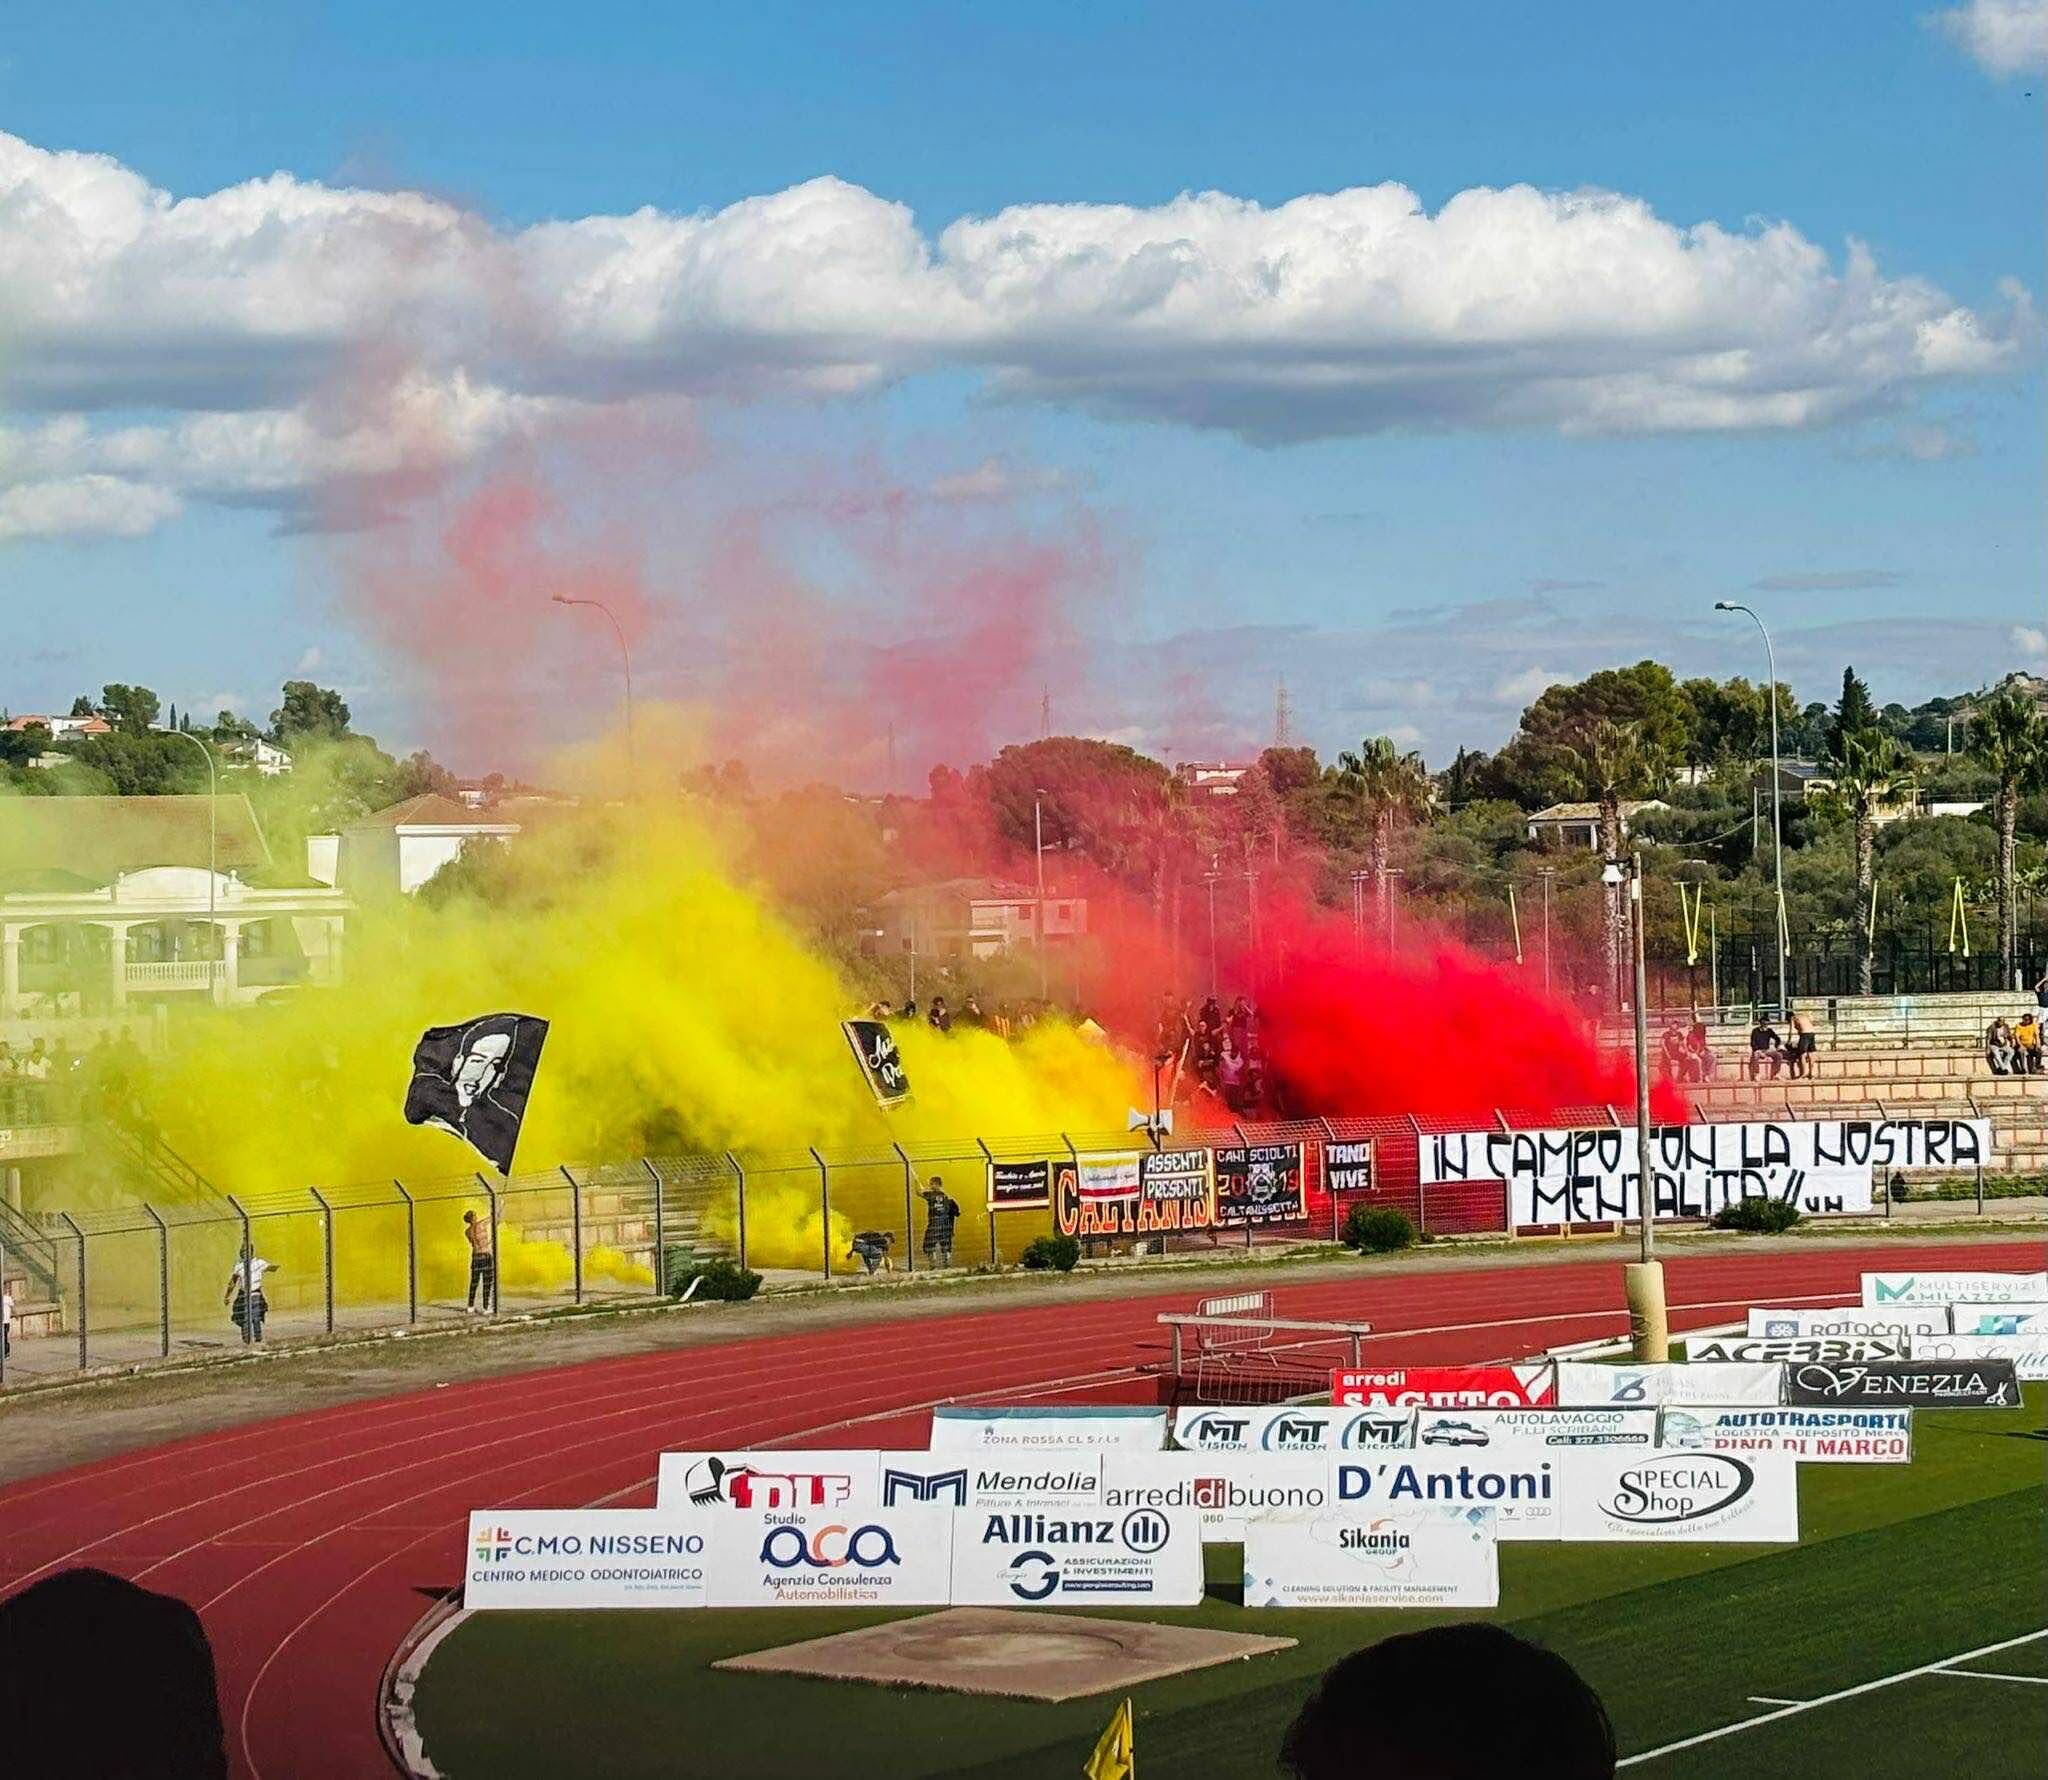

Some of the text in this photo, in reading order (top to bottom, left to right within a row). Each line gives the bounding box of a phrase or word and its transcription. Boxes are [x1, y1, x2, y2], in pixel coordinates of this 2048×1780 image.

[1217, 1145, 1299, 1163] CANI SCIOLTI
[1326, 1142, 1371, 1164] TANO
[1486, 1129, 1622, 1178] CAMPO
[1741, 1124, 1790, 1168] LA
[1814, 1121, 1980, 1166] NOSTRA
[1146, 1150, 1204, 1173] ASSENTI
[1146, 1177, 1204, 1199] PRESENTI
[1329, 1168, 1368, 1190] VIVE
[1919, 1280, 2036, 1292] MULTISERVIZI
[1920, 1293, 2012, 1301] MILAZZO
[1342, 1371, 1406, 1387] arredi
[1796, 1365, 1988, 1397] VENEZIA
[1495, 1413, 1625, 1425] AUTOLAVAGGIO
[1716, 1411, 1907, 1429] AUTOTRASPORTI
[1022, 1436, 1064, 1444] ROSSA
[1200, 1420, 1250, 1442] MT
[1278, 1420, 1329, 1442] MT
[1358, 1420, 1408, 1443] MT
[1714, 1428, 1780, 1438] LOGISTICA
[1796, 1428, 1860, 1438] DEPOSITO
[1199, 1441, 1248, 1450] VISION
[1278, 1441, 1328, 1450] VISION
[1816, 1438, 1905, 1455] MARCO
[976, 1471, 1097, 1491] Mendolia
[1338, 1462, 1552, 1500] D'Antoni
[1616, 1470, 1729, 1492] SPECIAL
[1613, 1484, 1694, 1516] Shop
[763, 1512, 807, 1525] Studio
[981, 1514, 1115, 1544] Allianz
[589, 1535, 704, 1555] NISSENO
[1339, 1528, 1410, 1549] Sikania
[1064, 1557, 1152, 1566] ASSICURAZIONI
[472, 1567, 703, 1583] CENTRO MEDICO ODONTOIATRICO
[1072, 1567, 1153, 1575] INVESTIMENTI
[763, 1573, 892, 1589] Agenzia Consulenza
[1282, 1585, 1321, 1593] CLEANING
[1322, 1585, 1361, 1593] SOLUTION
[1369, 1585, 1402, 1593] FACILITY
[1403, 1585, 1458, 1593] MANAGEMENT
[775, 1588, 878, 1601] Automobilistica
